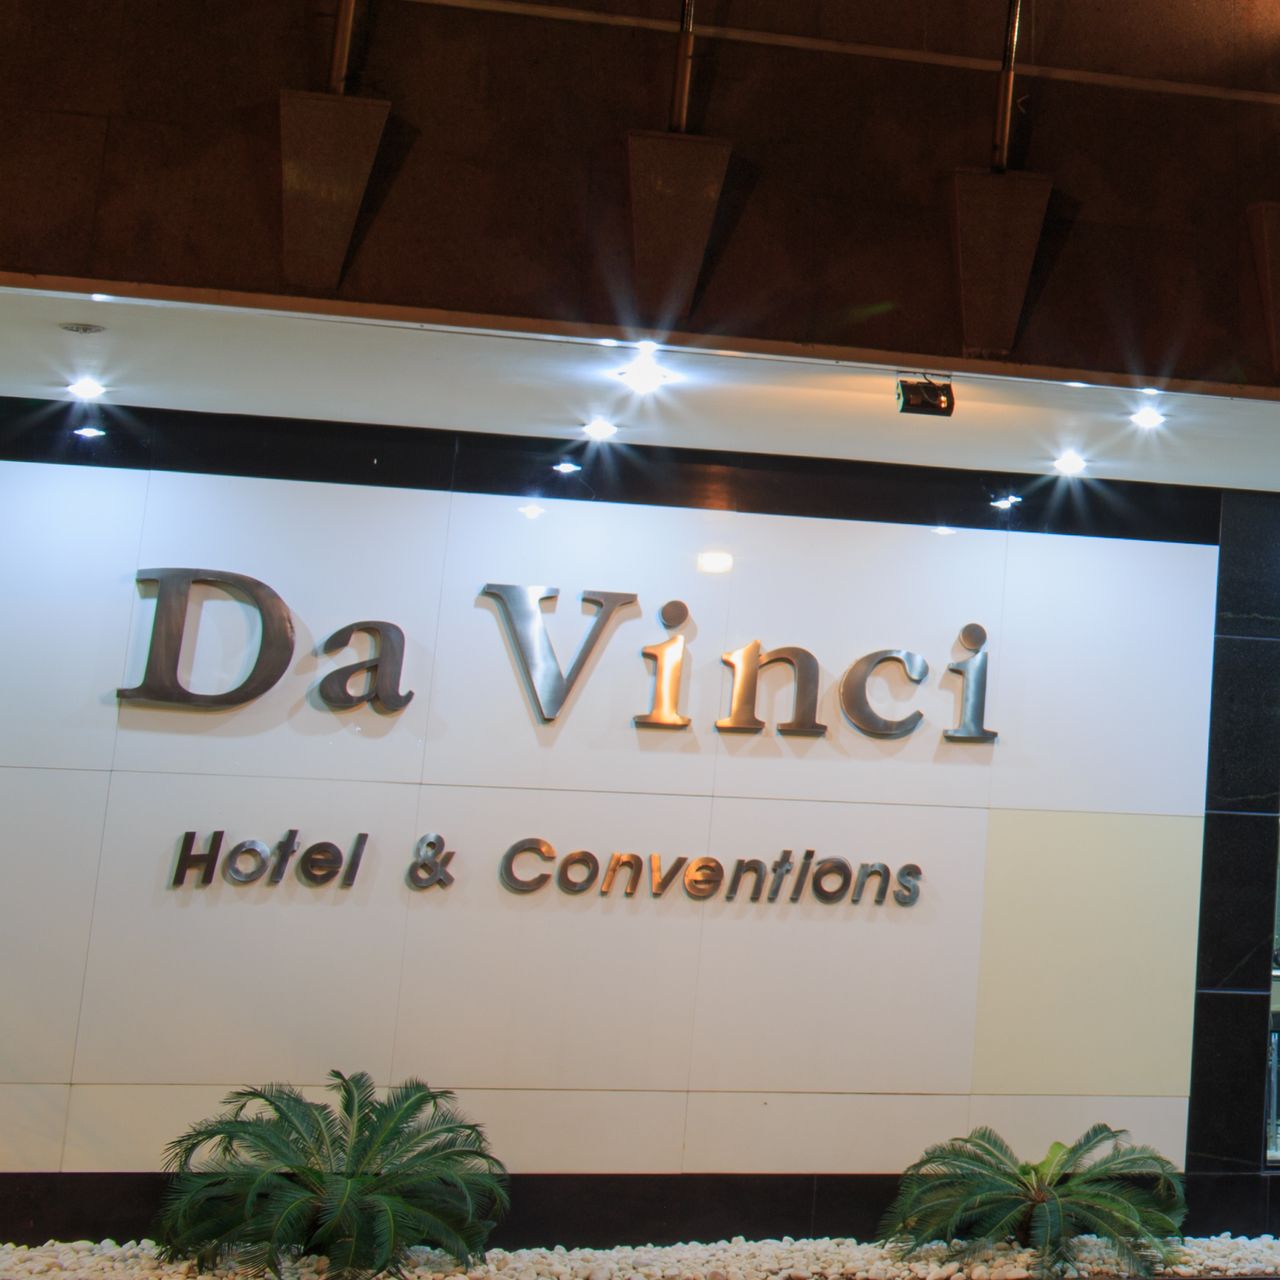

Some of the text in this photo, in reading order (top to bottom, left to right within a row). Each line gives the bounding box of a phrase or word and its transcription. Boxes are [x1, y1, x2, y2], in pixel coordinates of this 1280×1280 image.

[116, 567, 1000, 742] Da Vinci
[172, 828, 924, 907] Hotel & Conventions
